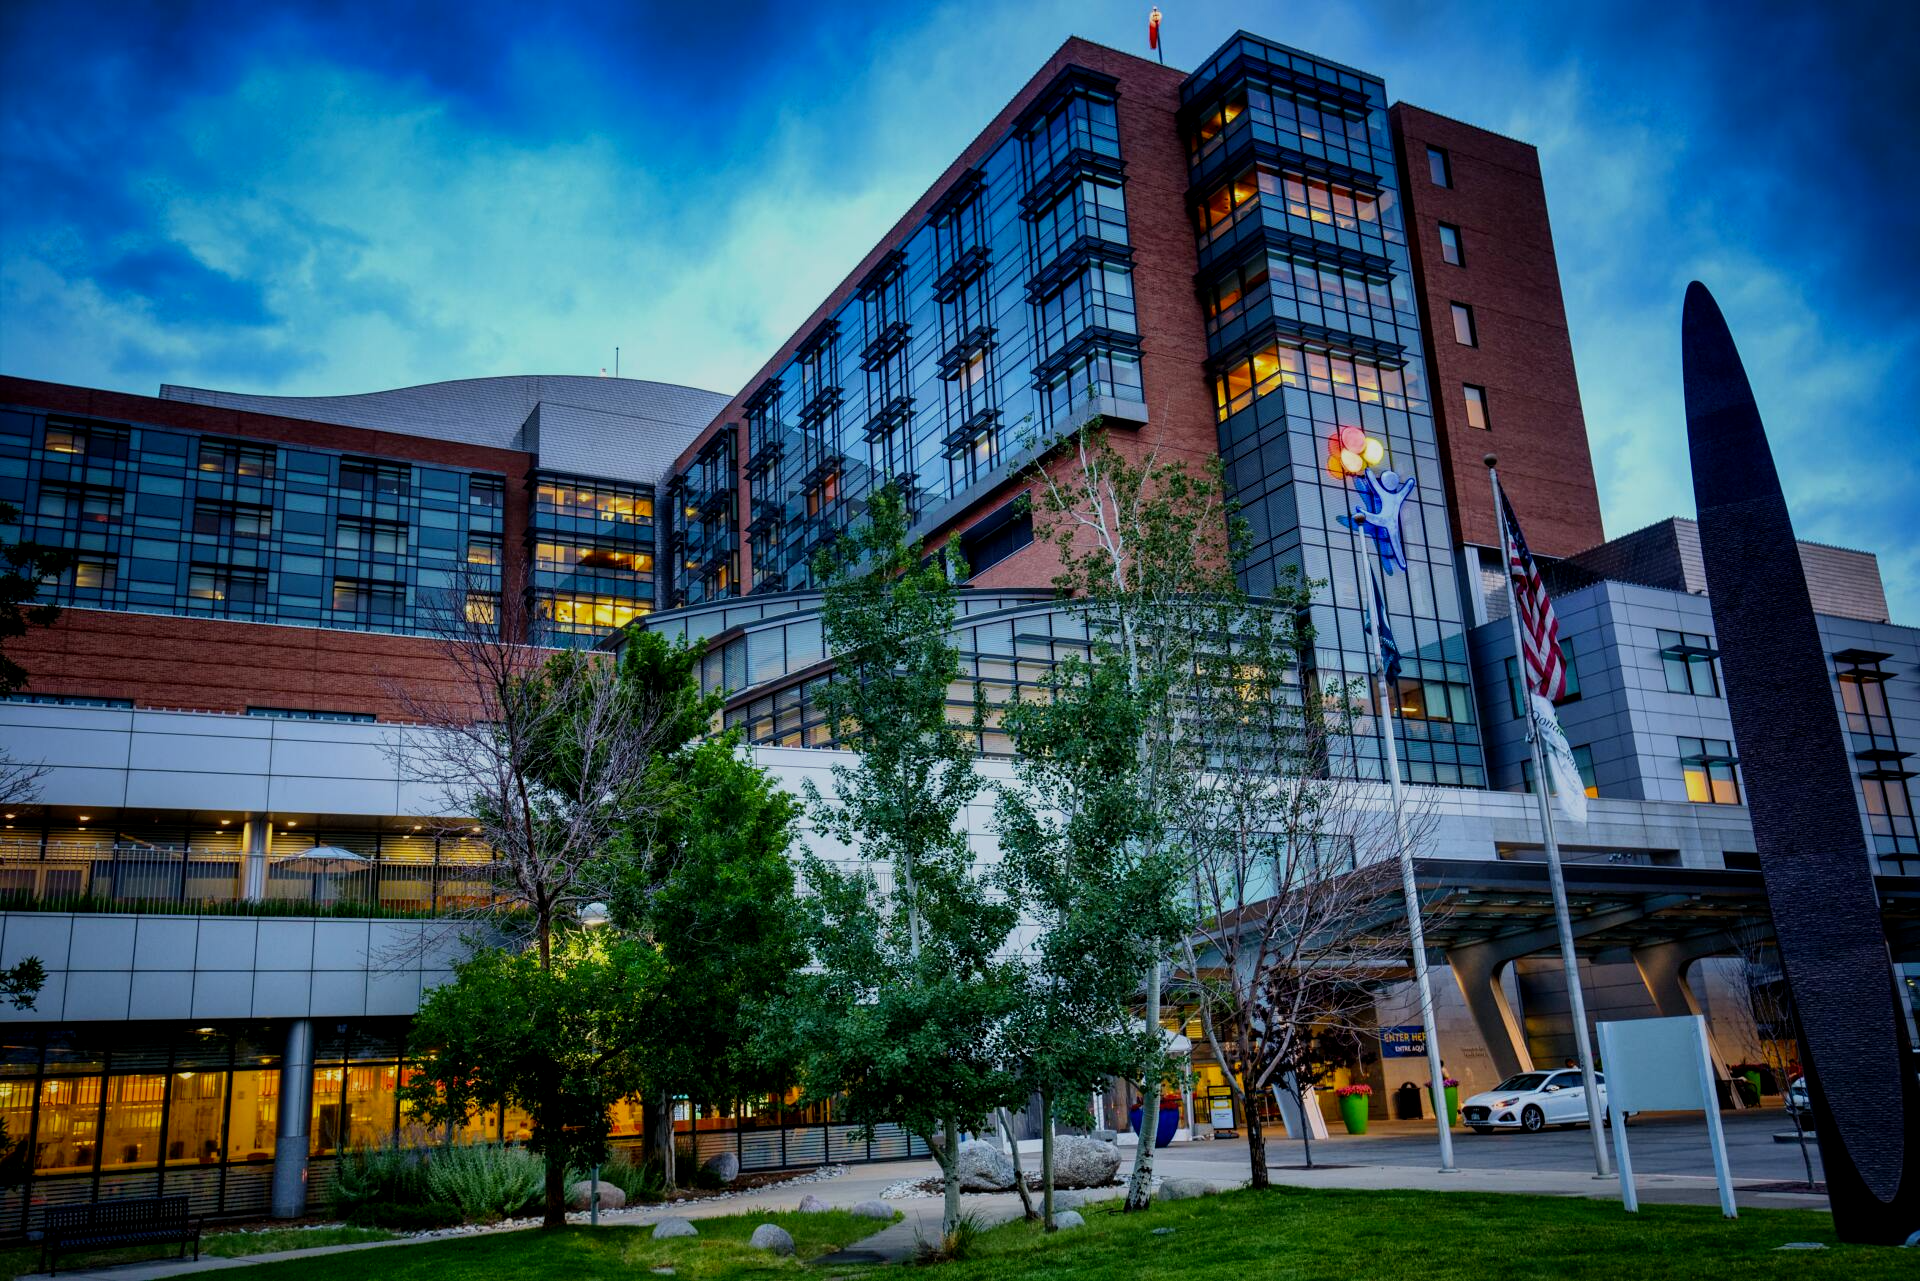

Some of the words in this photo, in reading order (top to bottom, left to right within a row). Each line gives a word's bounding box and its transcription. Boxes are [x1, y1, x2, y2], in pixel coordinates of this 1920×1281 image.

[1531, 710, 1561, 734] Dona
[1384, 1032, 1409, 1042] ENTER
[1412, 1032, 1426, 1041] HER
